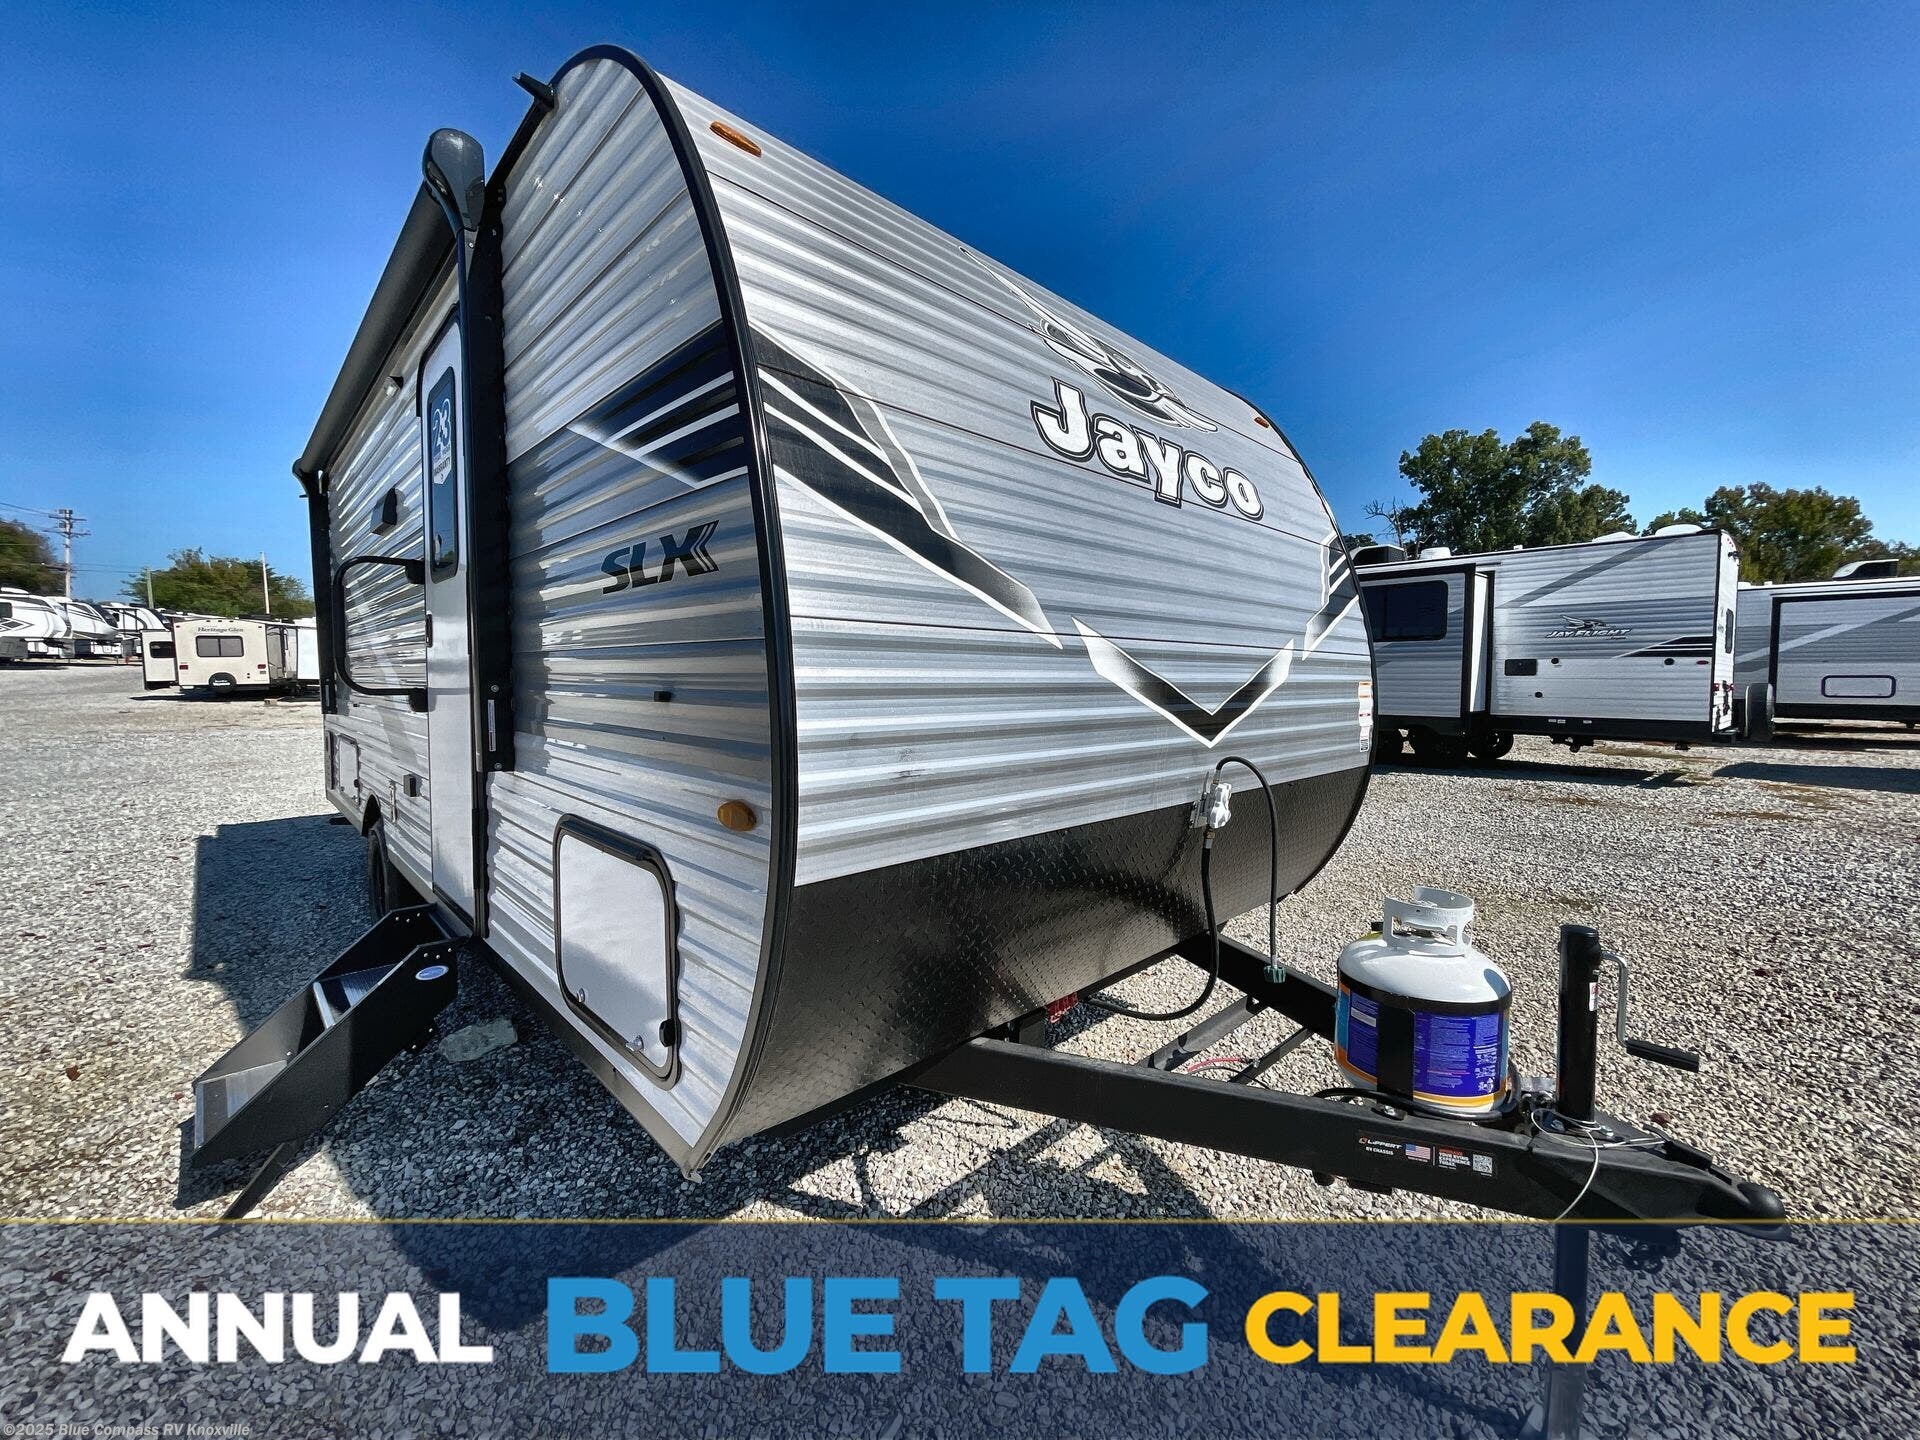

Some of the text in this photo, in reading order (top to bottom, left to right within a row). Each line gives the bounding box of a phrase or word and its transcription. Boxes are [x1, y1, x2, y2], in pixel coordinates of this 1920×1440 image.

[1030, 376, 1264, 521] Jayco
[601, 520, 719, 594] SLX
[1545, 629, 1632, 638] JAY FLIGHT
